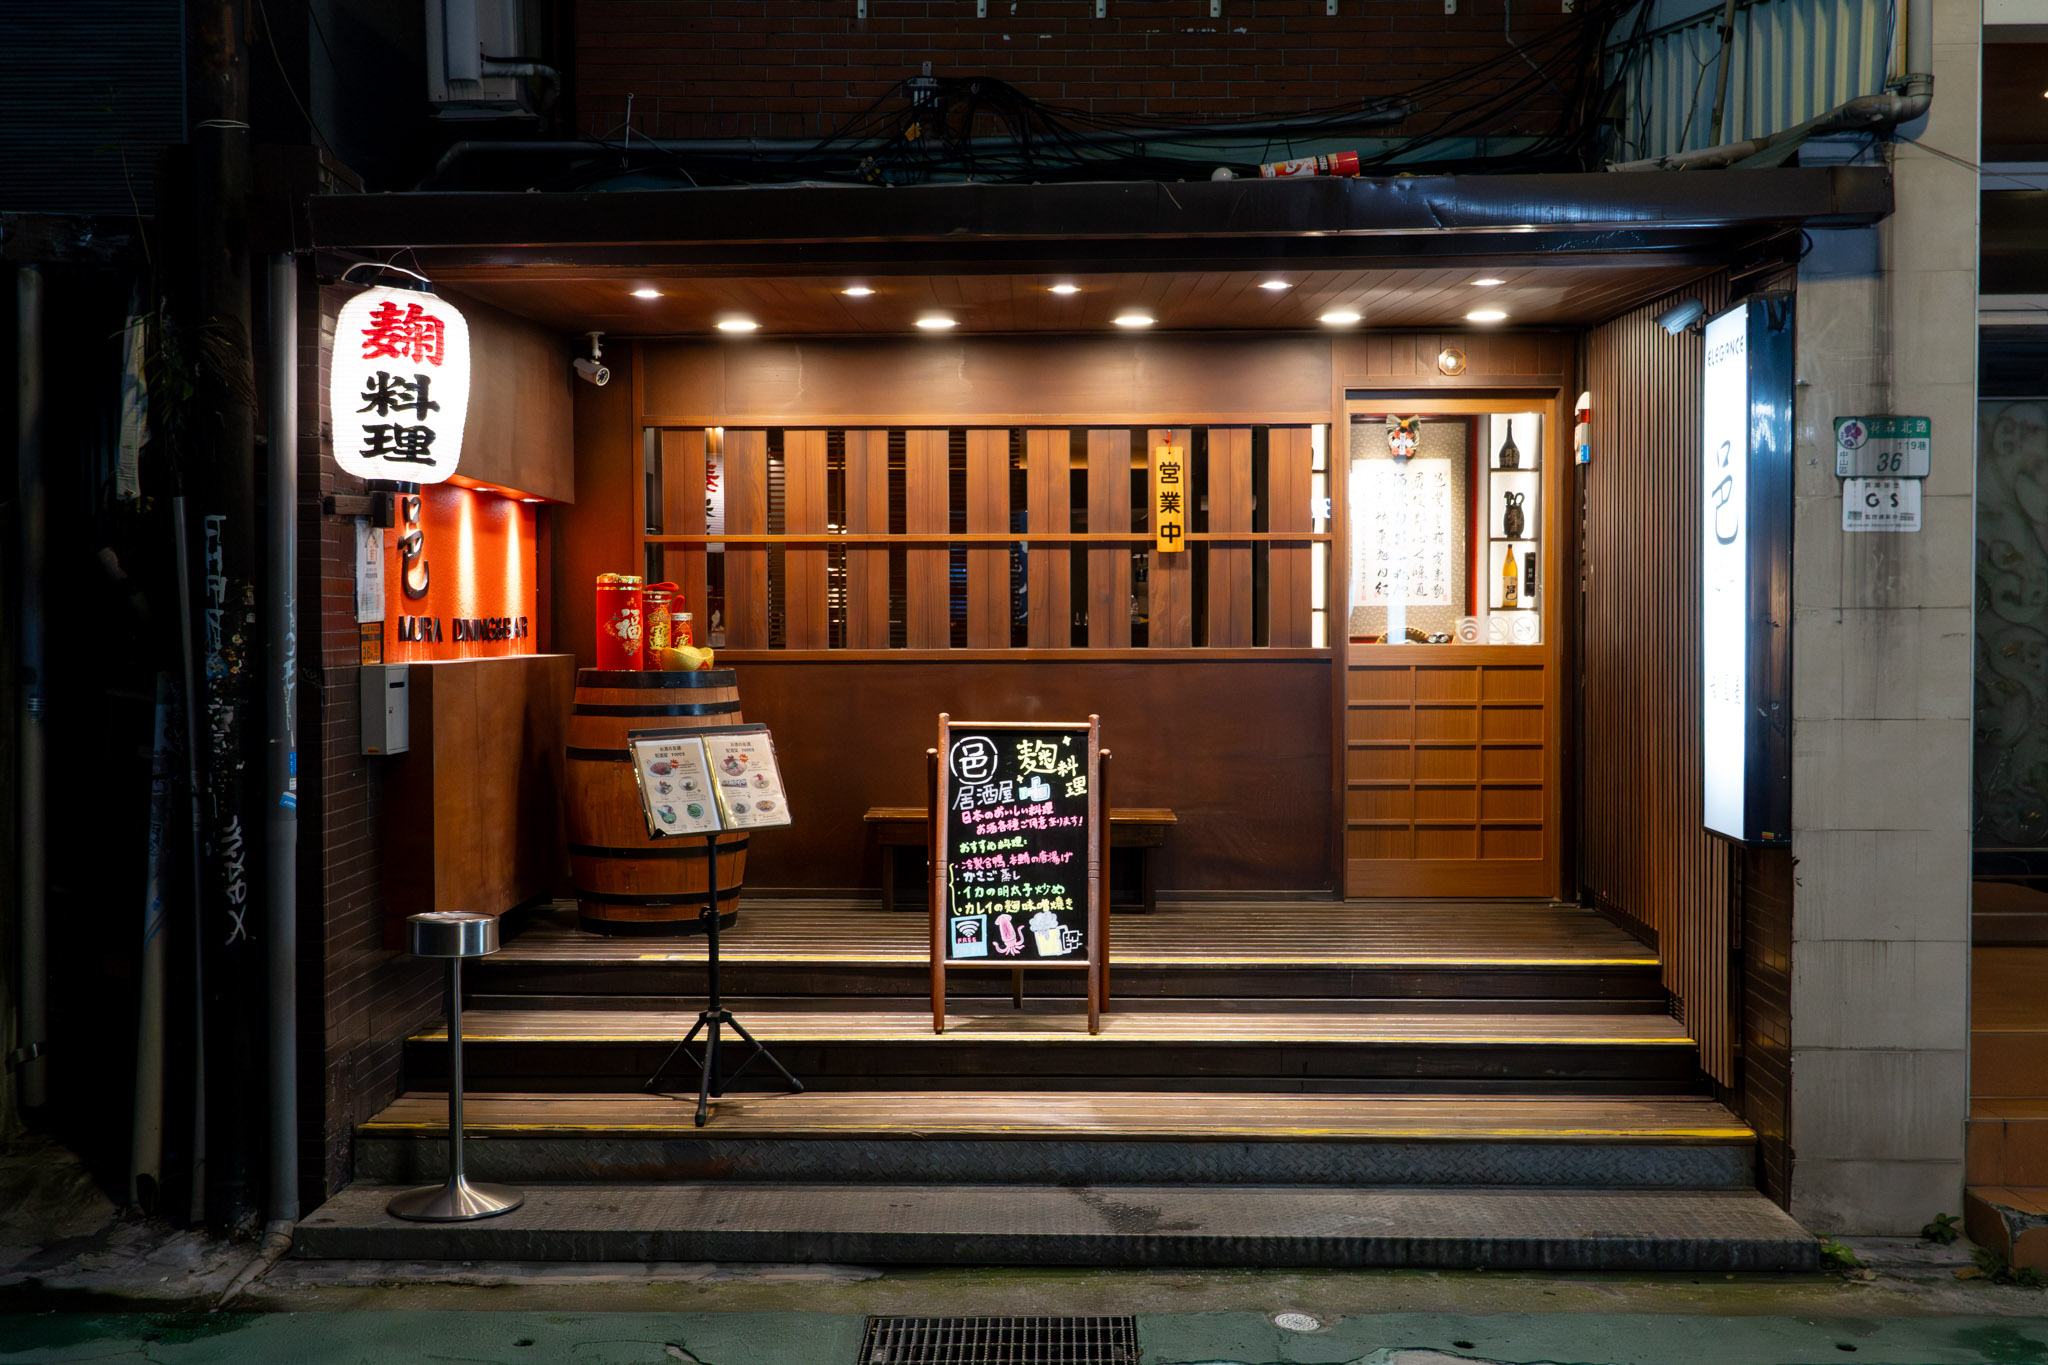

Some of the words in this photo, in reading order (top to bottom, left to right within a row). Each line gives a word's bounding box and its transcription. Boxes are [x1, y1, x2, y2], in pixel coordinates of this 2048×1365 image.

[1707, 335, 1744, 367] ELEGANCE
[1876, 452, 1903, 472] 36
[1159, 461, 1181, 544] 営業中
[398, 615, 443, 642] MURA
[958, 742, 989, 778] 邑
[952, 779, 1016, 811] 居酒屋
[961, 801, 1054, 825] 日本のおいしい料理
[957, 936, 977, 944] FREE
